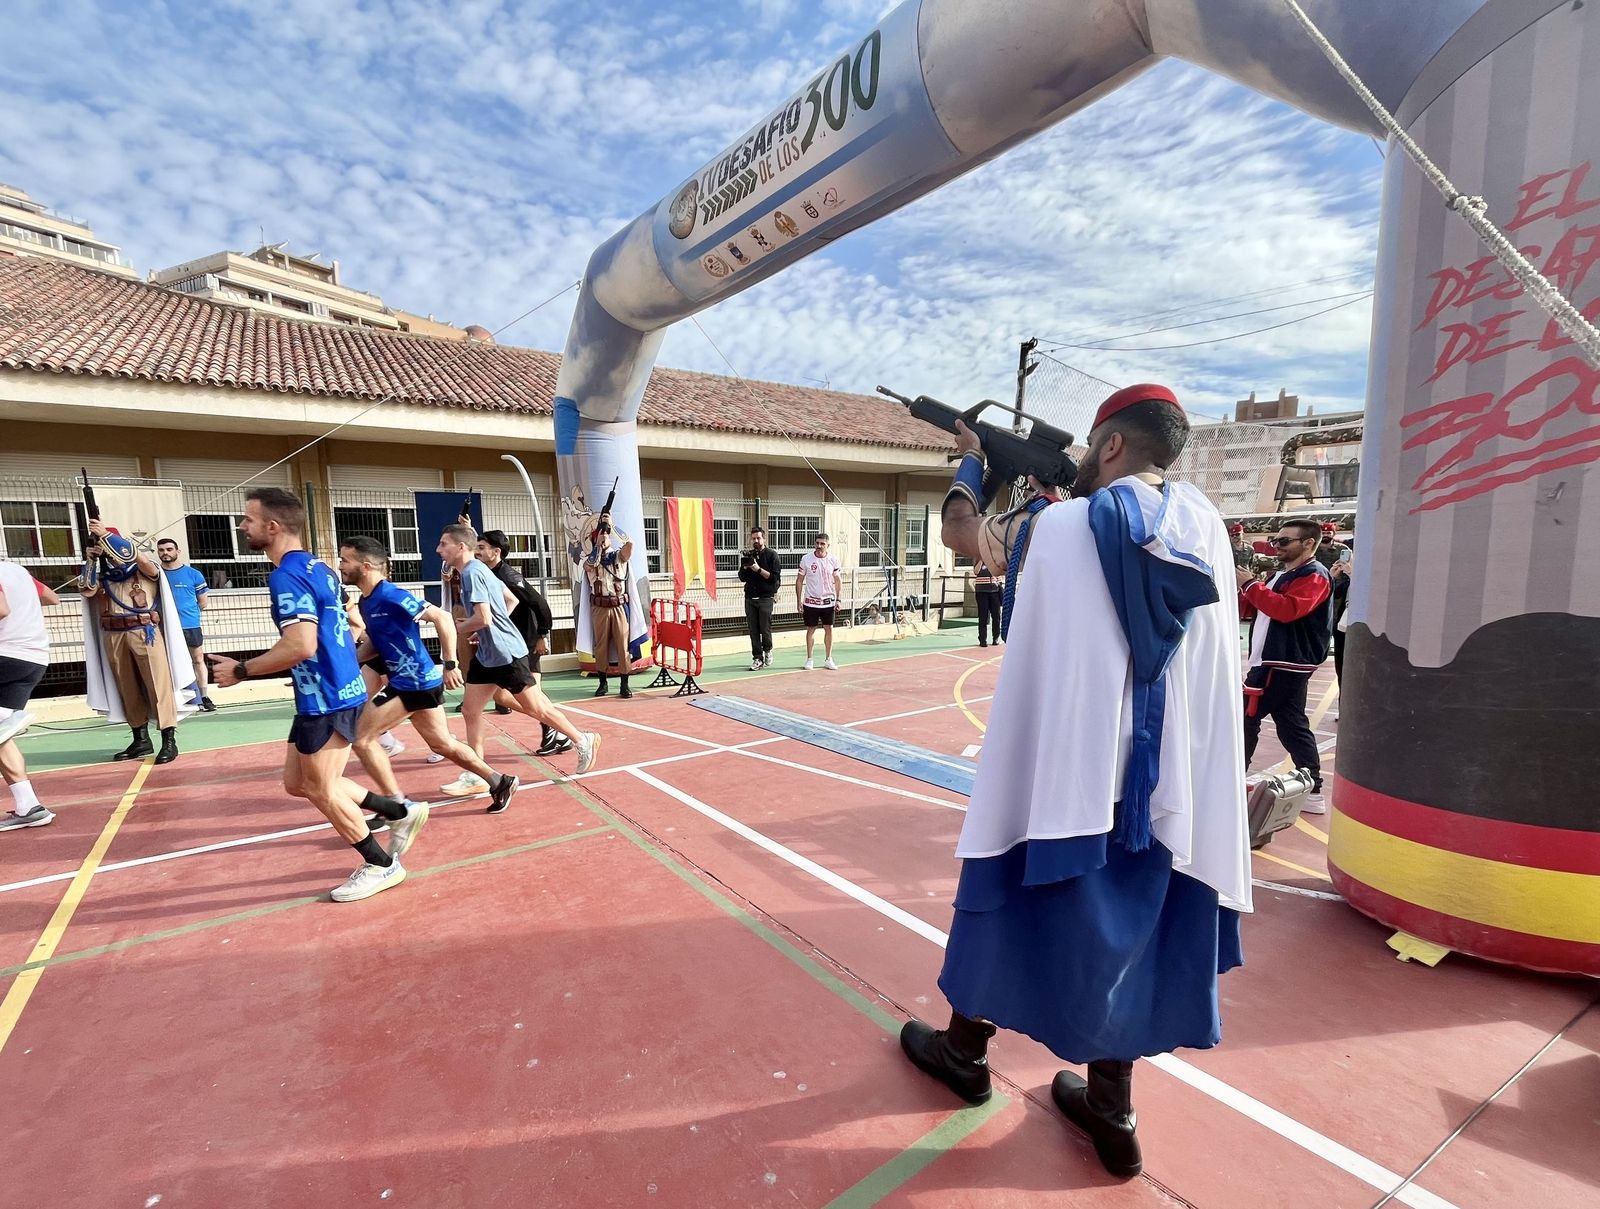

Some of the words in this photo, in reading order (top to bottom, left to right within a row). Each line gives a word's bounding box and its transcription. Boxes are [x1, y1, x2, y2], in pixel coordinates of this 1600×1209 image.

[800, 29, 881, 155] 300
[758, 154, 775, 185] DE
[777, 136, 800, 172] LOS
[1504, 160, 1600, 232] EL
[1417, 310, 1539, 387] DE
[277, 592, 316, 615] 54
